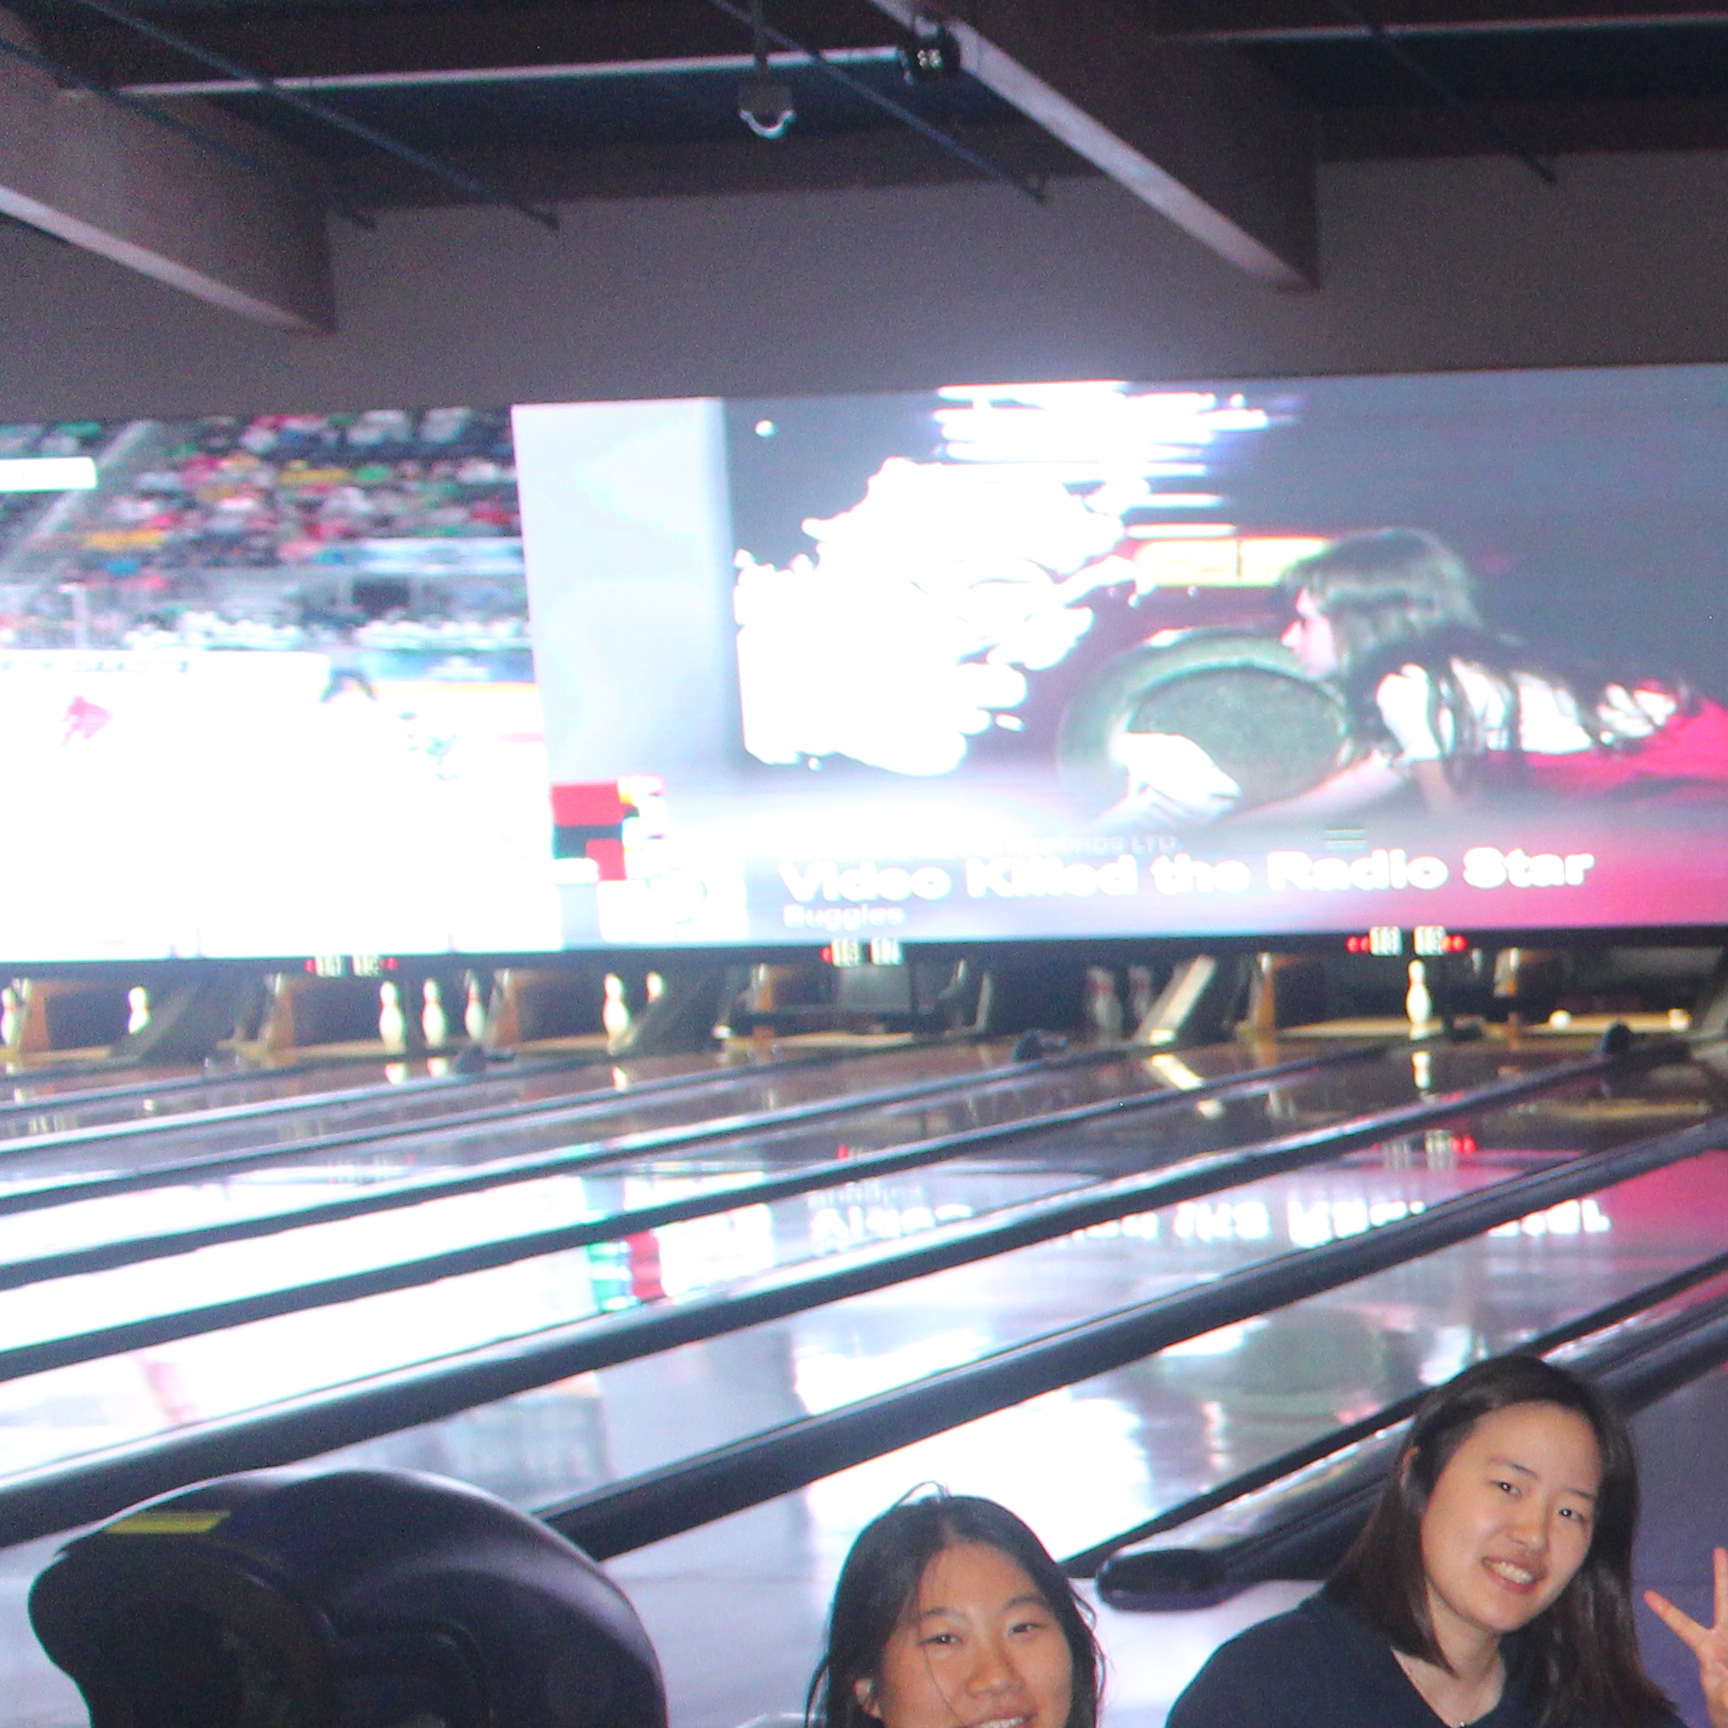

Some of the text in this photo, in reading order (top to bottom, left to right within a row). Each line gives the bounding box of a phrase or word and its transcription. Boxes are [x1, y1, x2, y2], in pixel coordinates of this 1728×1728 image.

[777, 846, 1596, 901] Video Killed the Radio Star
